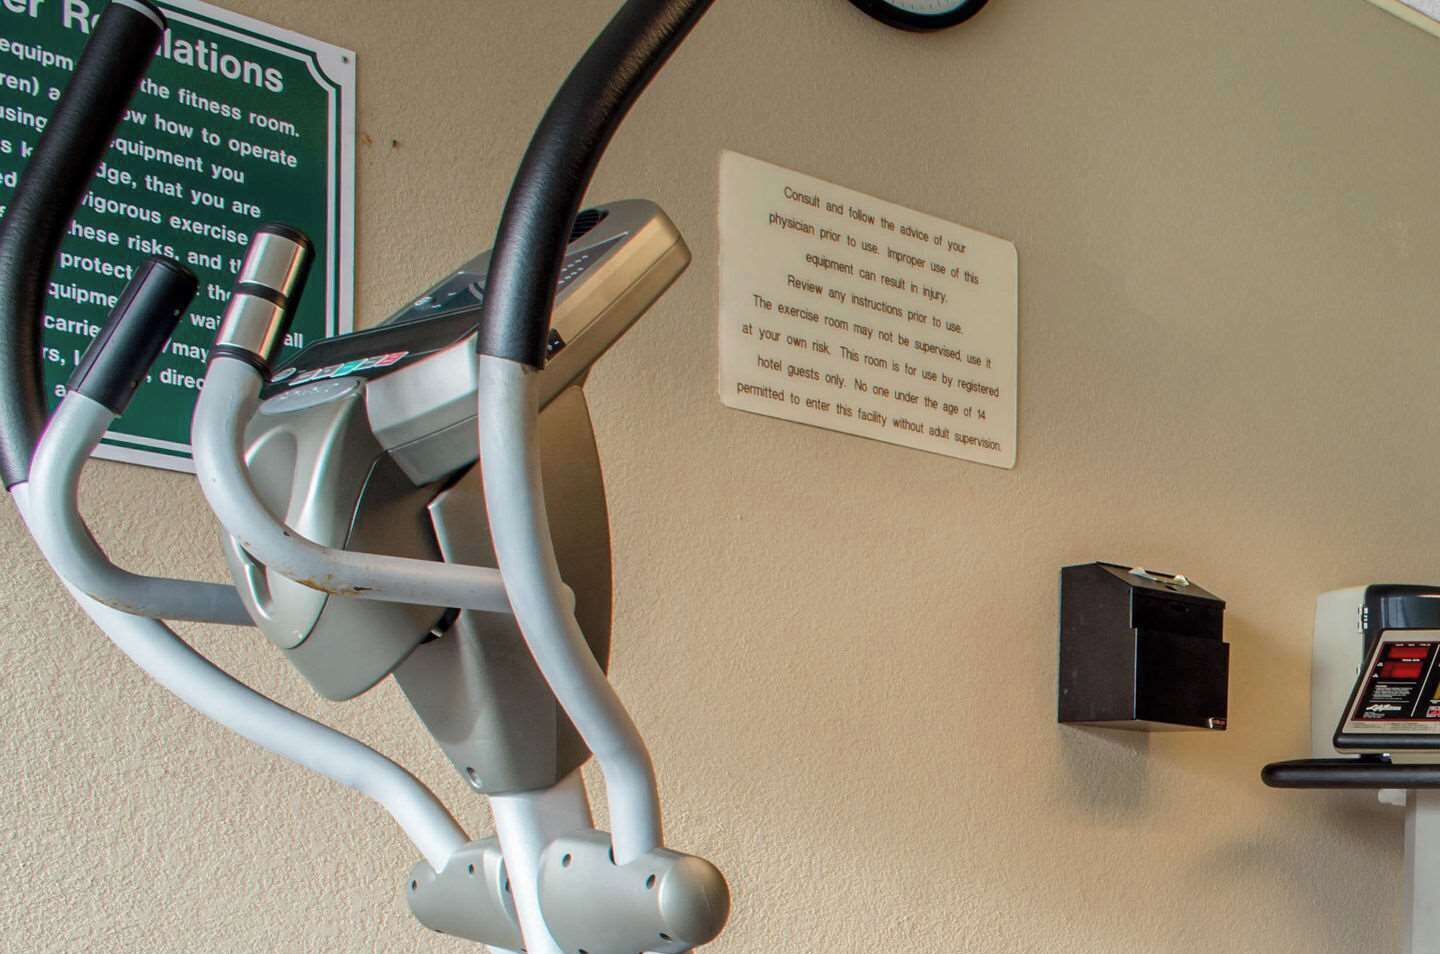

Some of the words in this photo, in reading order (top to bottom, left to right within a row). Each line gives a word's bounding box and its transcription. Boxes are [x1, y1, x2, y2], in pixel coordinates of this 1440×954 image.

[178, 88, 242, 121] fitness
[249, 112, 300, 138] room.
[110, 136, 204, 173] quipment
[211, 163, 245, 184] you
[154, 113, 194, 138] how
[201, 127, 221, 147] to
[228, 139, 298, 168] operate
[144, 174, 184, 199] that
[191, 188, 225, 209] you
[231, 199, 262, 218] are
[784, 186, 820, 208] Consult
[826, 201, 844, 215] and
[849, 206, 875, 225] follow
[881, 216, 895, 231] the
[900, 224, 929, 242] advice
[934, 235, 943, 246] of
[947, 239, 966, 254] your
[67, 219, 120, 246] hese
[187, 250, 222, 271] and
[169, 214, 249, 246] exercise
[769, 212, 815, 235] physician
[820, 227, 840, 242] prior
[847, 235, 856, 247] to
[887, 247, 927, 269] Improper
[930, 261, 946, 273] use
[950, 267, 959, 278] of
[964, 270, 979, 284] this
[806, 253, 854, 275] equipment
[859, 269, 876, 281] can
[881, 274, 905, 289] result
[910, 283, 918, 294] in
[788, 275, 823, 295] Review
[829, 286, 846, 303] any
[851, 295, 903, 316] instructions
[908, 309, 927, 326] prior
[932, 316, 941, 327] to
[754, 295, 772, 311] The
[778, 302, 819, 322] exercise
[824, 316, 848, 330] room
[853, 323, 873, 339] may
[878, 328, 893, 342] not
[898, 334, 910, 346] be
[966, 354, 982, 366] use
[986, 358, 992, 368] it
[742, 323, 753, 334] at
[758, 328, 780, 342] your
[787, 335, 807, 349] own
[840, 346, 859, 362] This
[864, 354, 888, 368] room
[892, 359, 900, 371] is
[905, 364, 917, 376] for
[922, 368, 937, 381] use
[942, 373, 953, 386] by
[957, 378, 1000, 398] registered
[737, 381, 784, 401] permitted
[790, 392, 800, 405] to
[806, 397, 830, 412] enter
[836, 402, 852, 417] this
[858, 408, 888, 426] facility
[892, 416, 924, 433] without
[929, 424, 950, 440] adult
[758, 356, 782, 371] hotel
[788, 364, 820, 381] guests
[825, 374, 846, 389] only.
[854, 379, 868, 392] No
[873, 385, 889, 397] one
[894, 389, 919, 407] under
[924, 396, 938, 409] the
[943, 401, 959, 415] age
[963, 407, 972, 417] of
[977, 409, 986, 419] 14
